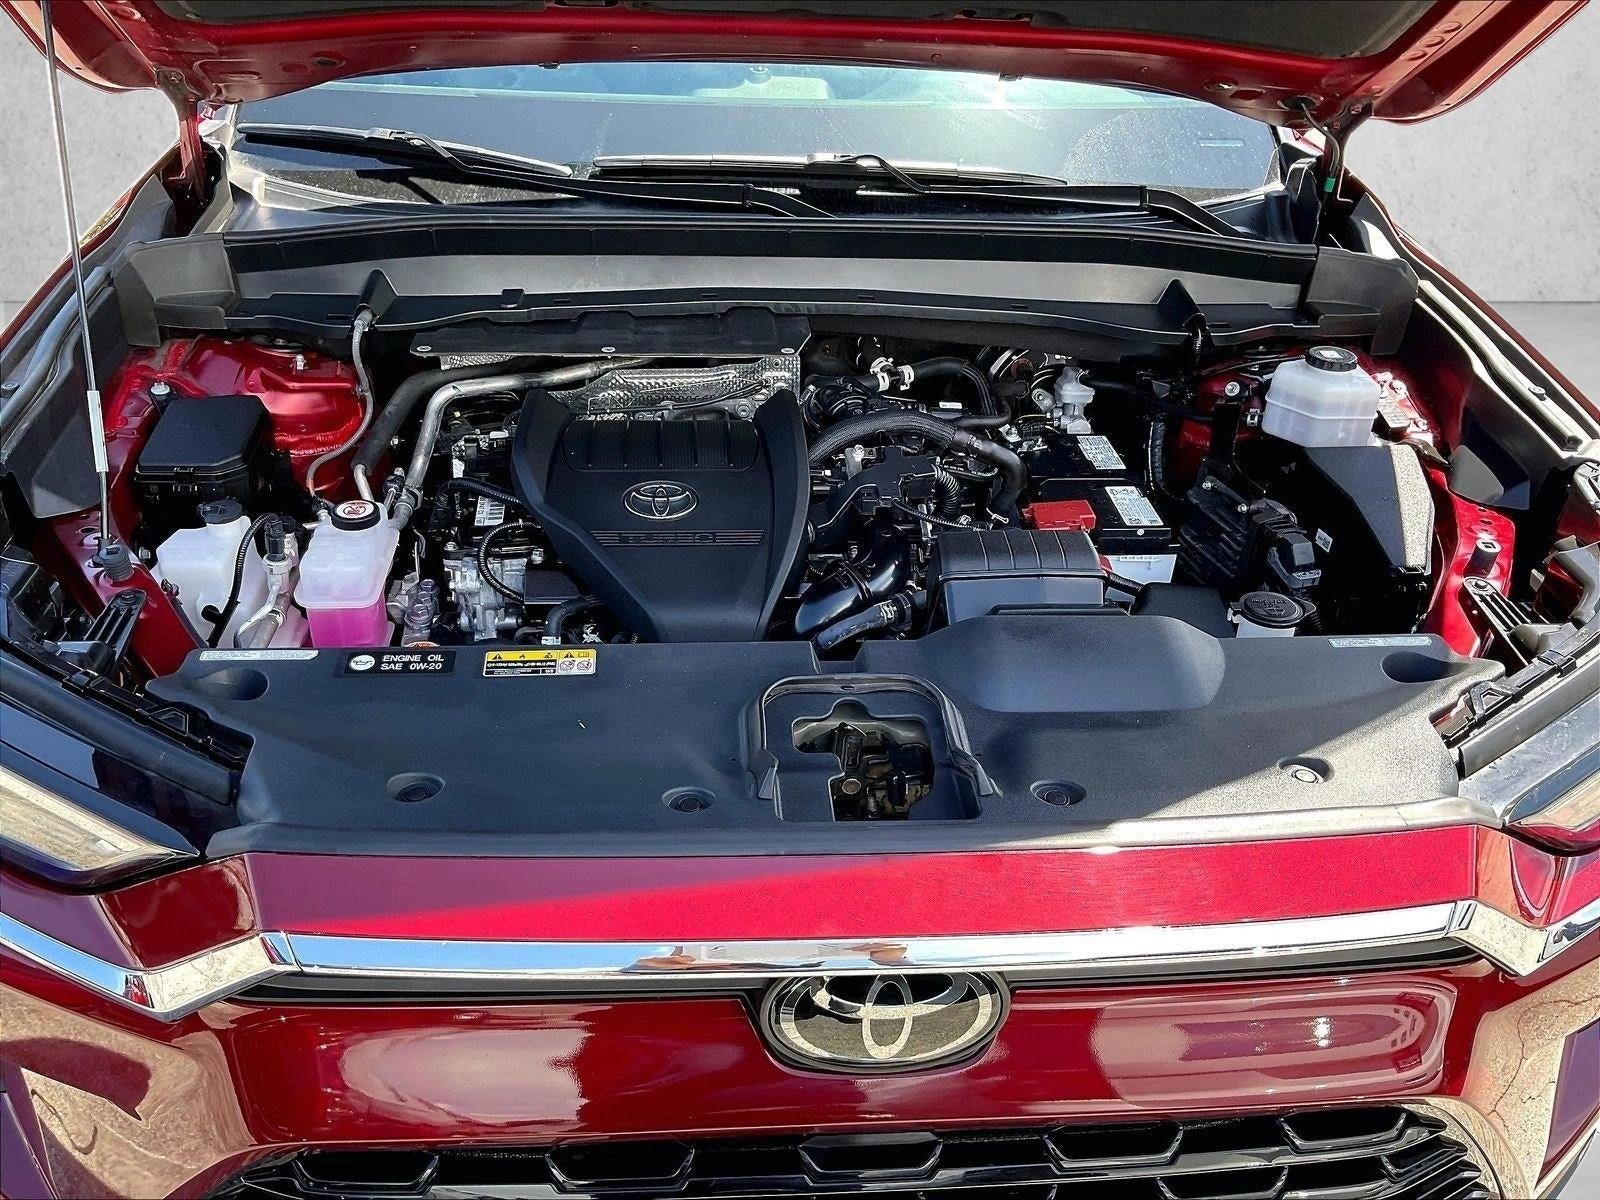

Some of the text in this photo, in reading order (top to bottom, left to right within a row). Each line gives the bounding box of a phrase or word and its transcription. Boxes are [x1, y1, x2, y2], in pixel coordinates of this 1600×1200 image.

[382, 654, 445, 662] ENGINE OIL
[380, 662, 443, 670] SAE 0W-20
